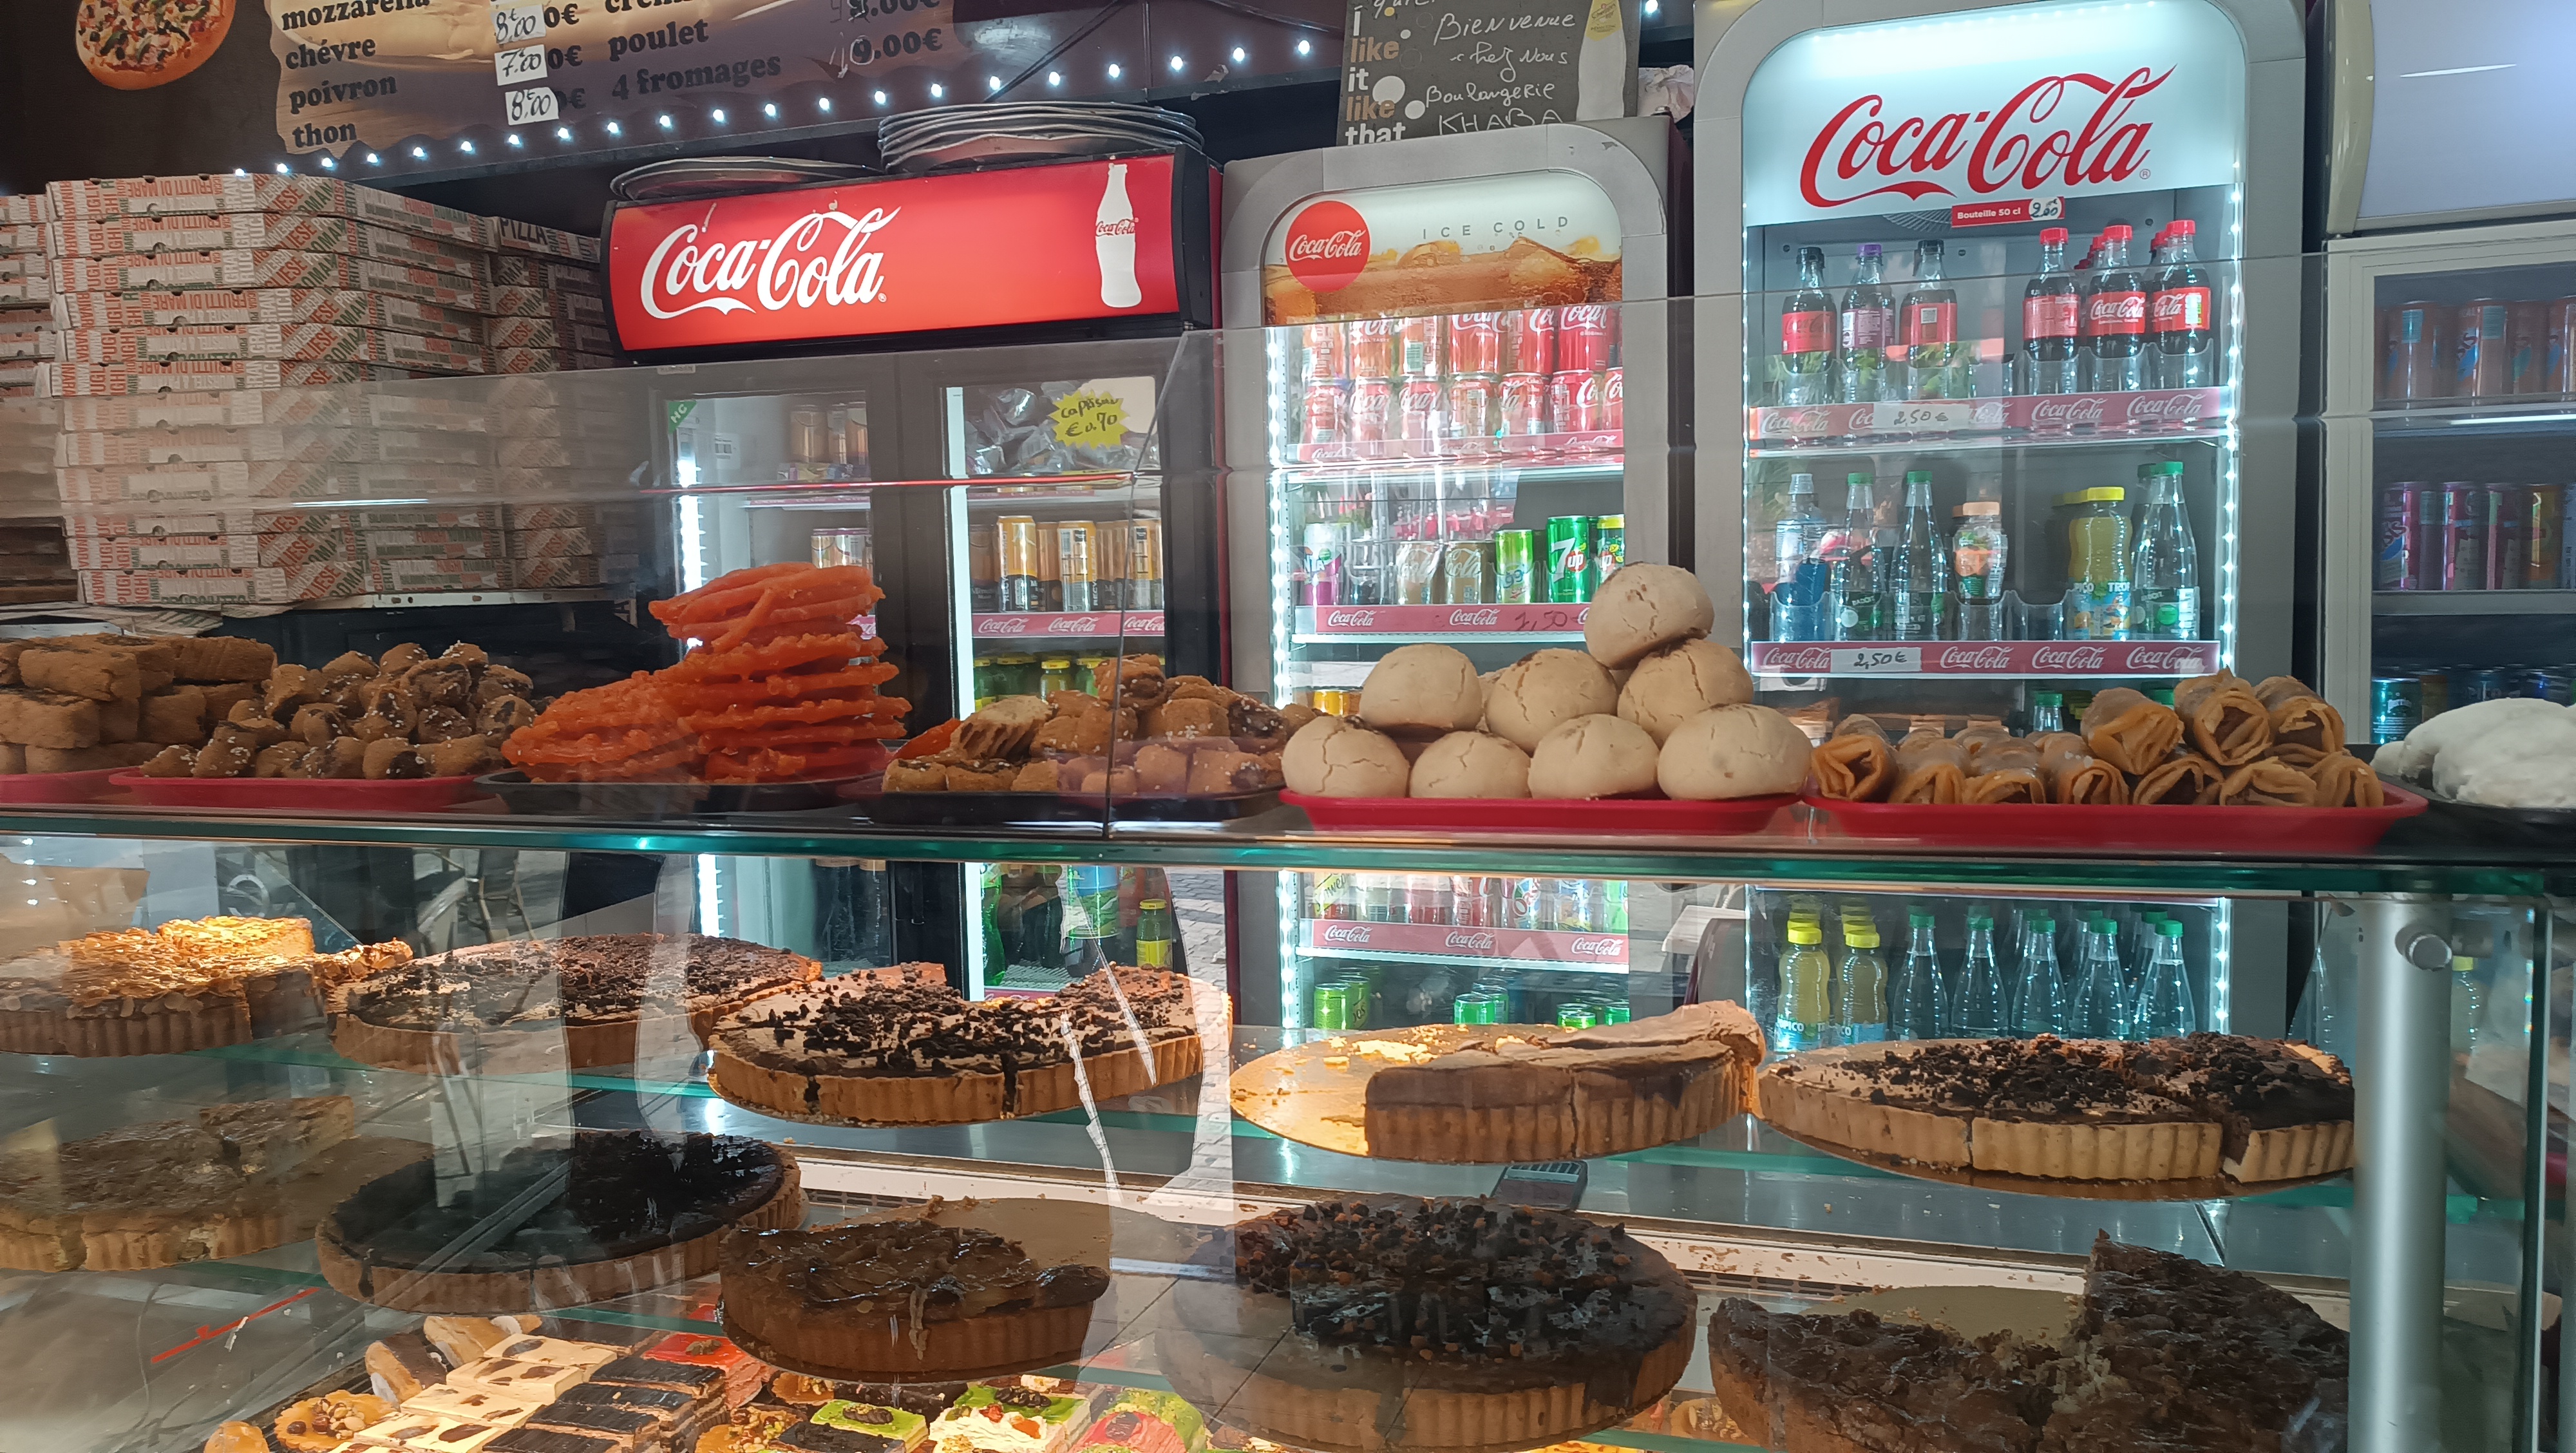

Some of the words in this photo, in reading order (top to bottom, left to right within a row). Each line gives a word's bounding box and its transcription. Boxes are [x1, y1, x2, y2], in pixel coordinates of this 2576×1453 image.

[607, 19, 709, 62] poulet
[1350, 37, 1399, 62] like
[612, 74, 630, 100] 4
[636, 56, 781, 94] fromages
[1349, 67, 1369, 92] it
[289, 75, 397, 115] poivron
[1346, 95, 1395, 122] like
[292, 122, 357, 148] thon
[1345, 122, 1406, 146] that
[1800, 63, 2178, 207] Coca-Cola
[1957, 209, 1996, 220] Bouteille
[1998, 208, 2011, 216] 50
[1423, 225, 1472, 240] ICE
[1493, 216, 1569, 234] COLD
[1289, 229, 1366, 261] Coca-Cola
[640, 208, 901, 319] Coca-Cola
[1325, 924, 1373, 943] Coca-Cola
[1445, 931, 1495, 950] Coca-Cola
[1571, 937, 1624, 956] Coca-Cola
